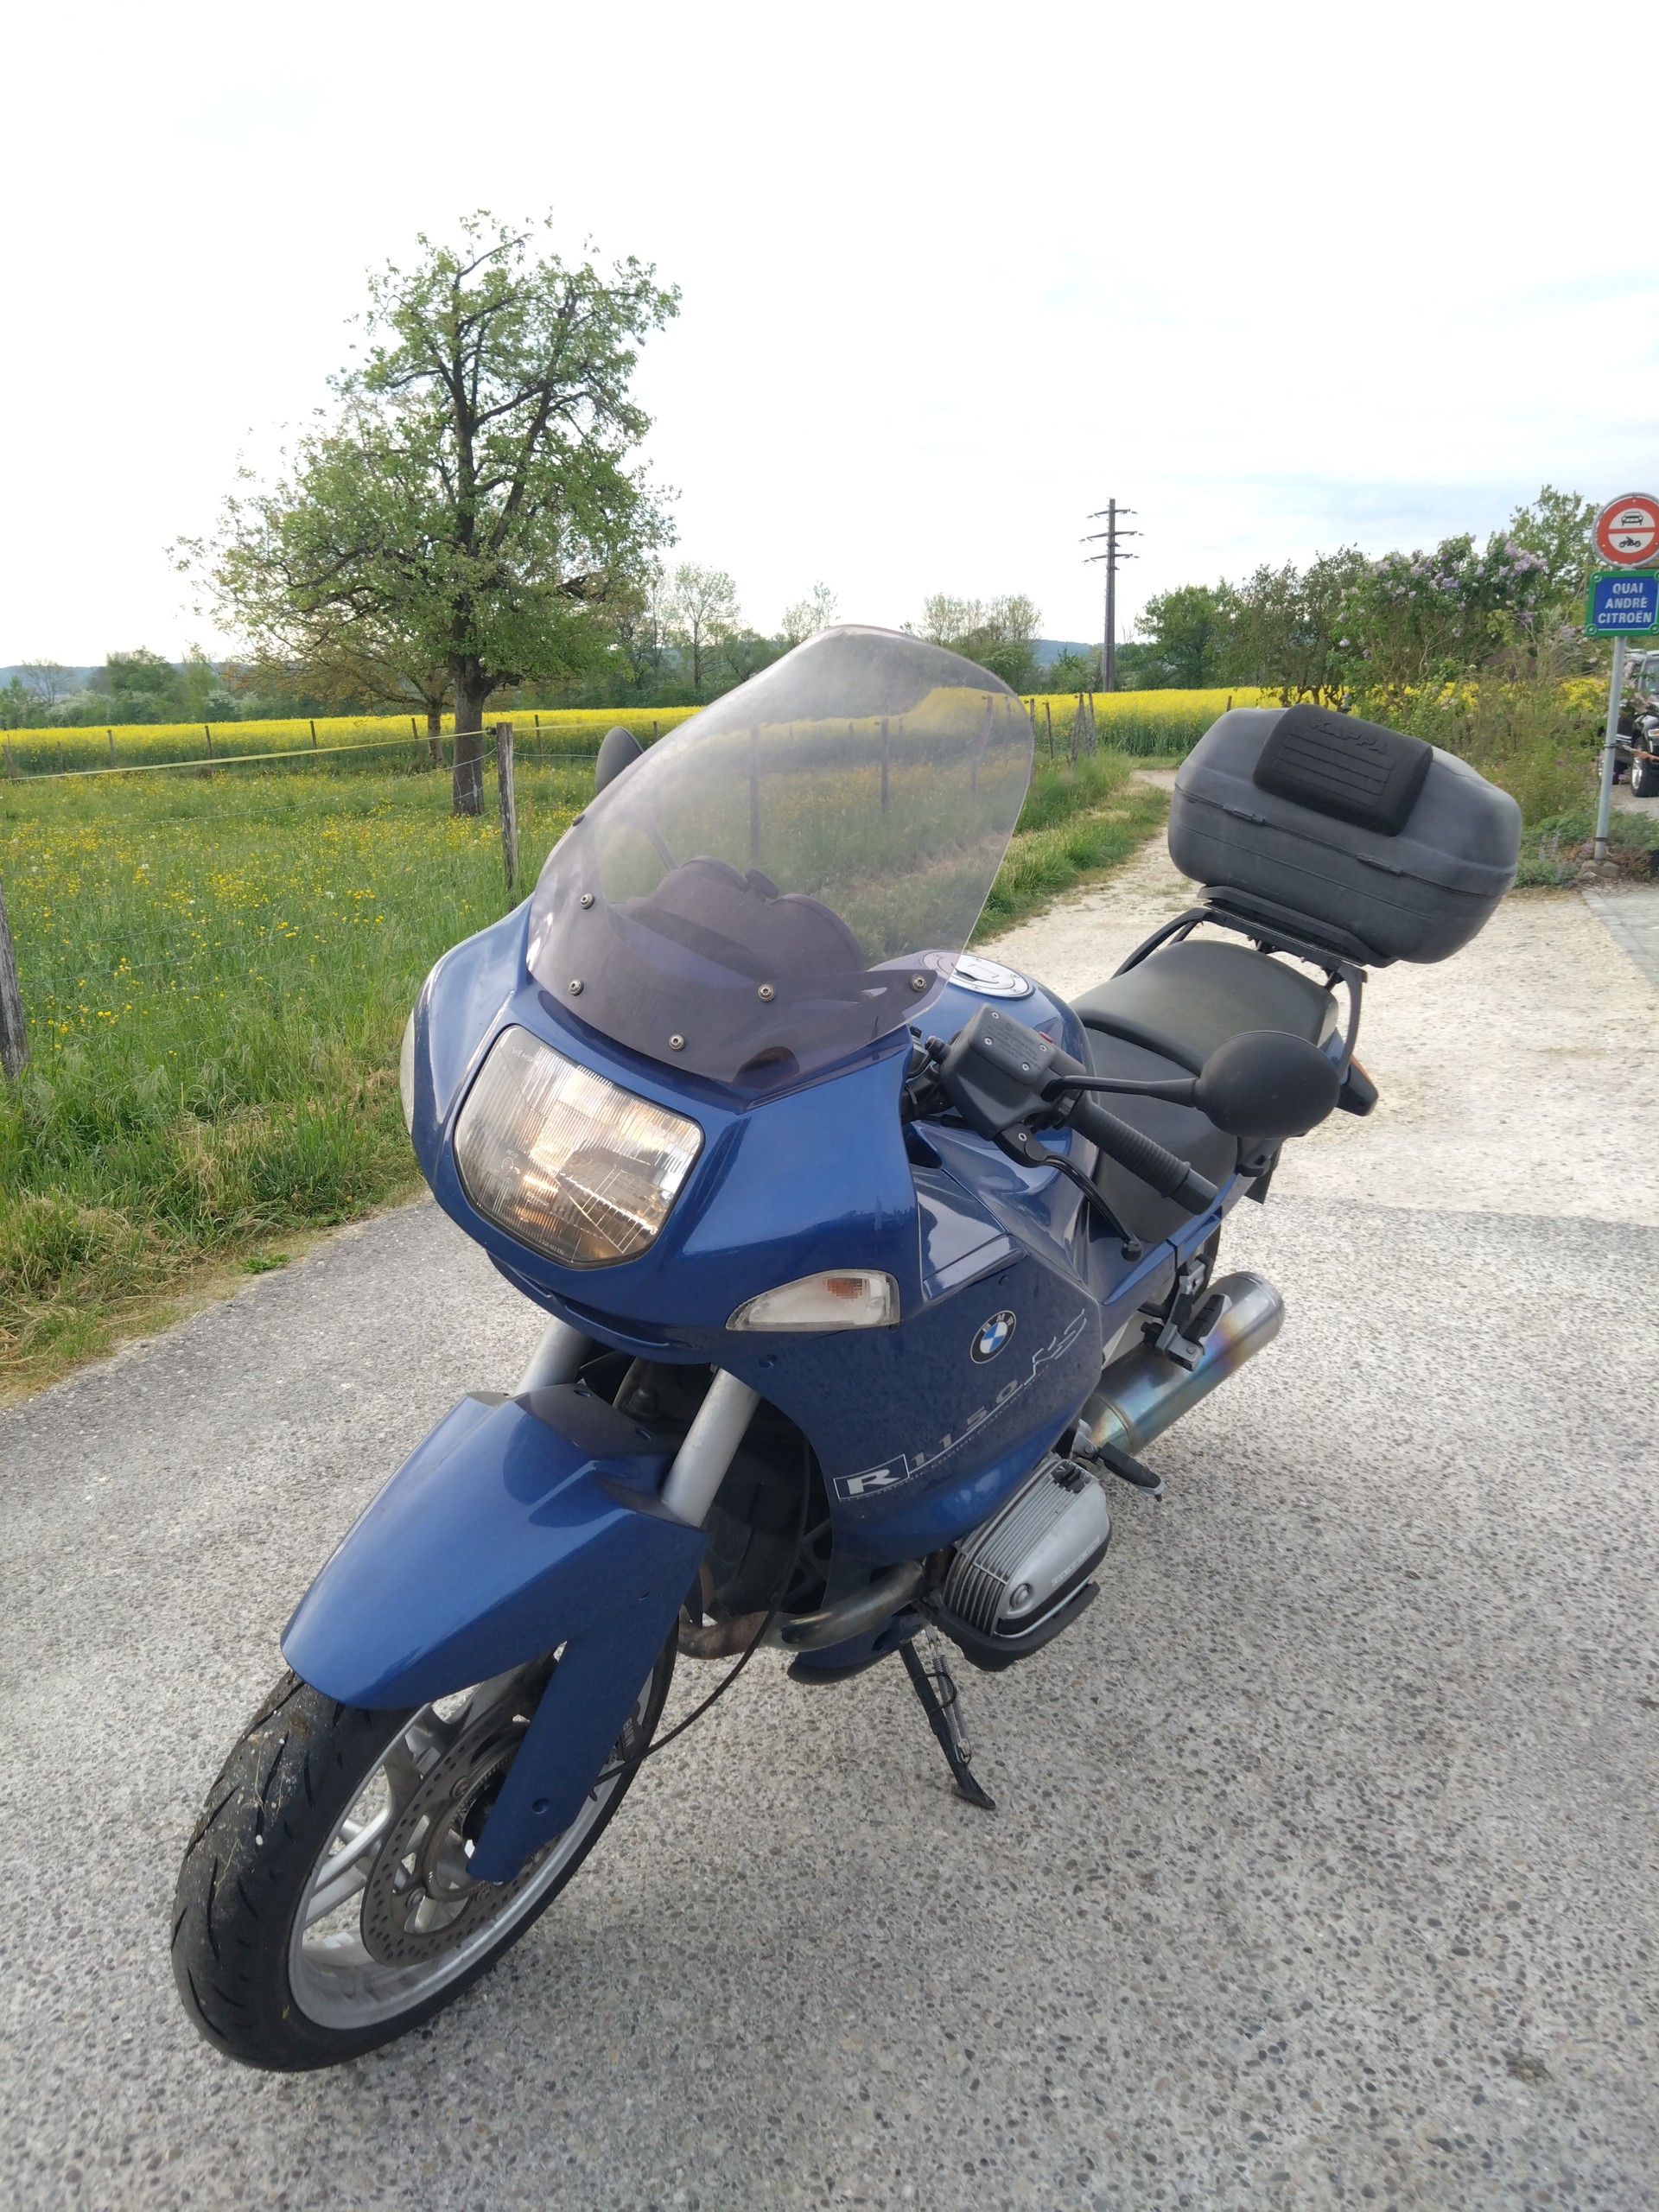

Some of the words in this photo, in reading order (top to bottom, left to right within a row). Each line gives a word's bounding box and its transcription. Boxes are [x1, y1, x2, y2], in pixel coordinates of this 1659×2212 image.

[1612, 582, 1643, 594] QUAI
[1605, 596, 1648, 609] ANDRÉ
[1598, 610, 1652, 624] CITROËN
[1310, 718, 1388, 755] KAPPA
